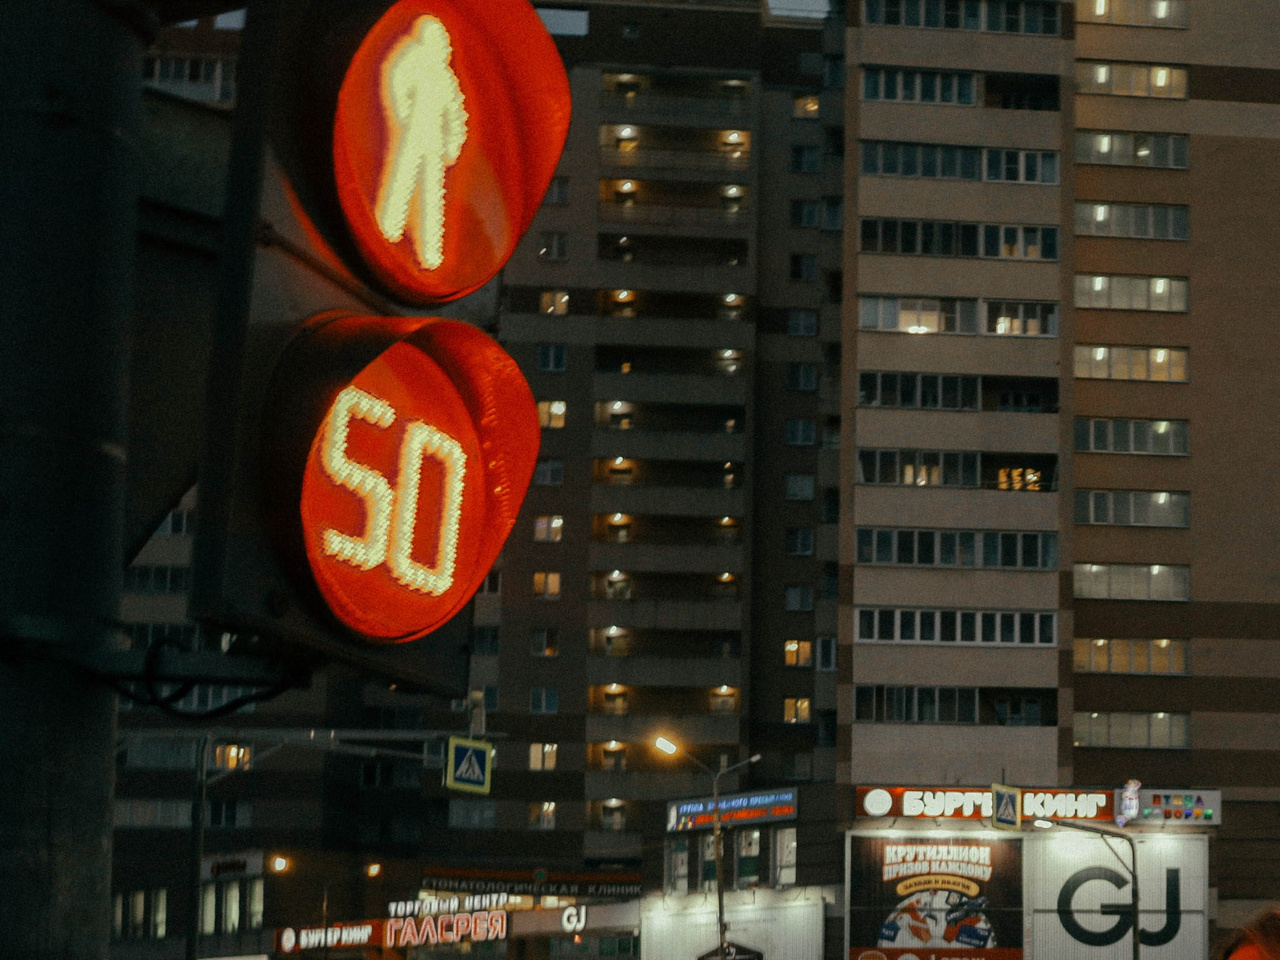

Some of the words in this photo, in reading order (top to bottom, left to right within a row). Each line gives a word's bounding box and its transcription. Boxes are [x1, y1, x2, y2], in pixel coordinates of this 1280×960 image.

[322, 385, 467, 597] 50
[903, 791, 993, 818] БУРГЕ
[1022, 792, 1107, 819] КИНГ
[884, 844, 991, 865] КРУТИЛЛИОН
[883, 861, 930, 881] ПРИЗОВ
[930, 860, 992, 881] КАЖДОМУ
[588, 883, 642, 896] КЛИНИК
[388, 894, 460, 917] ТОРГОВЫЙ
[465, 892, 508, 911] ЦЕНТР
[1057, 866, 1180, 946] GJ
[562, 905, 586, 932] GJ
